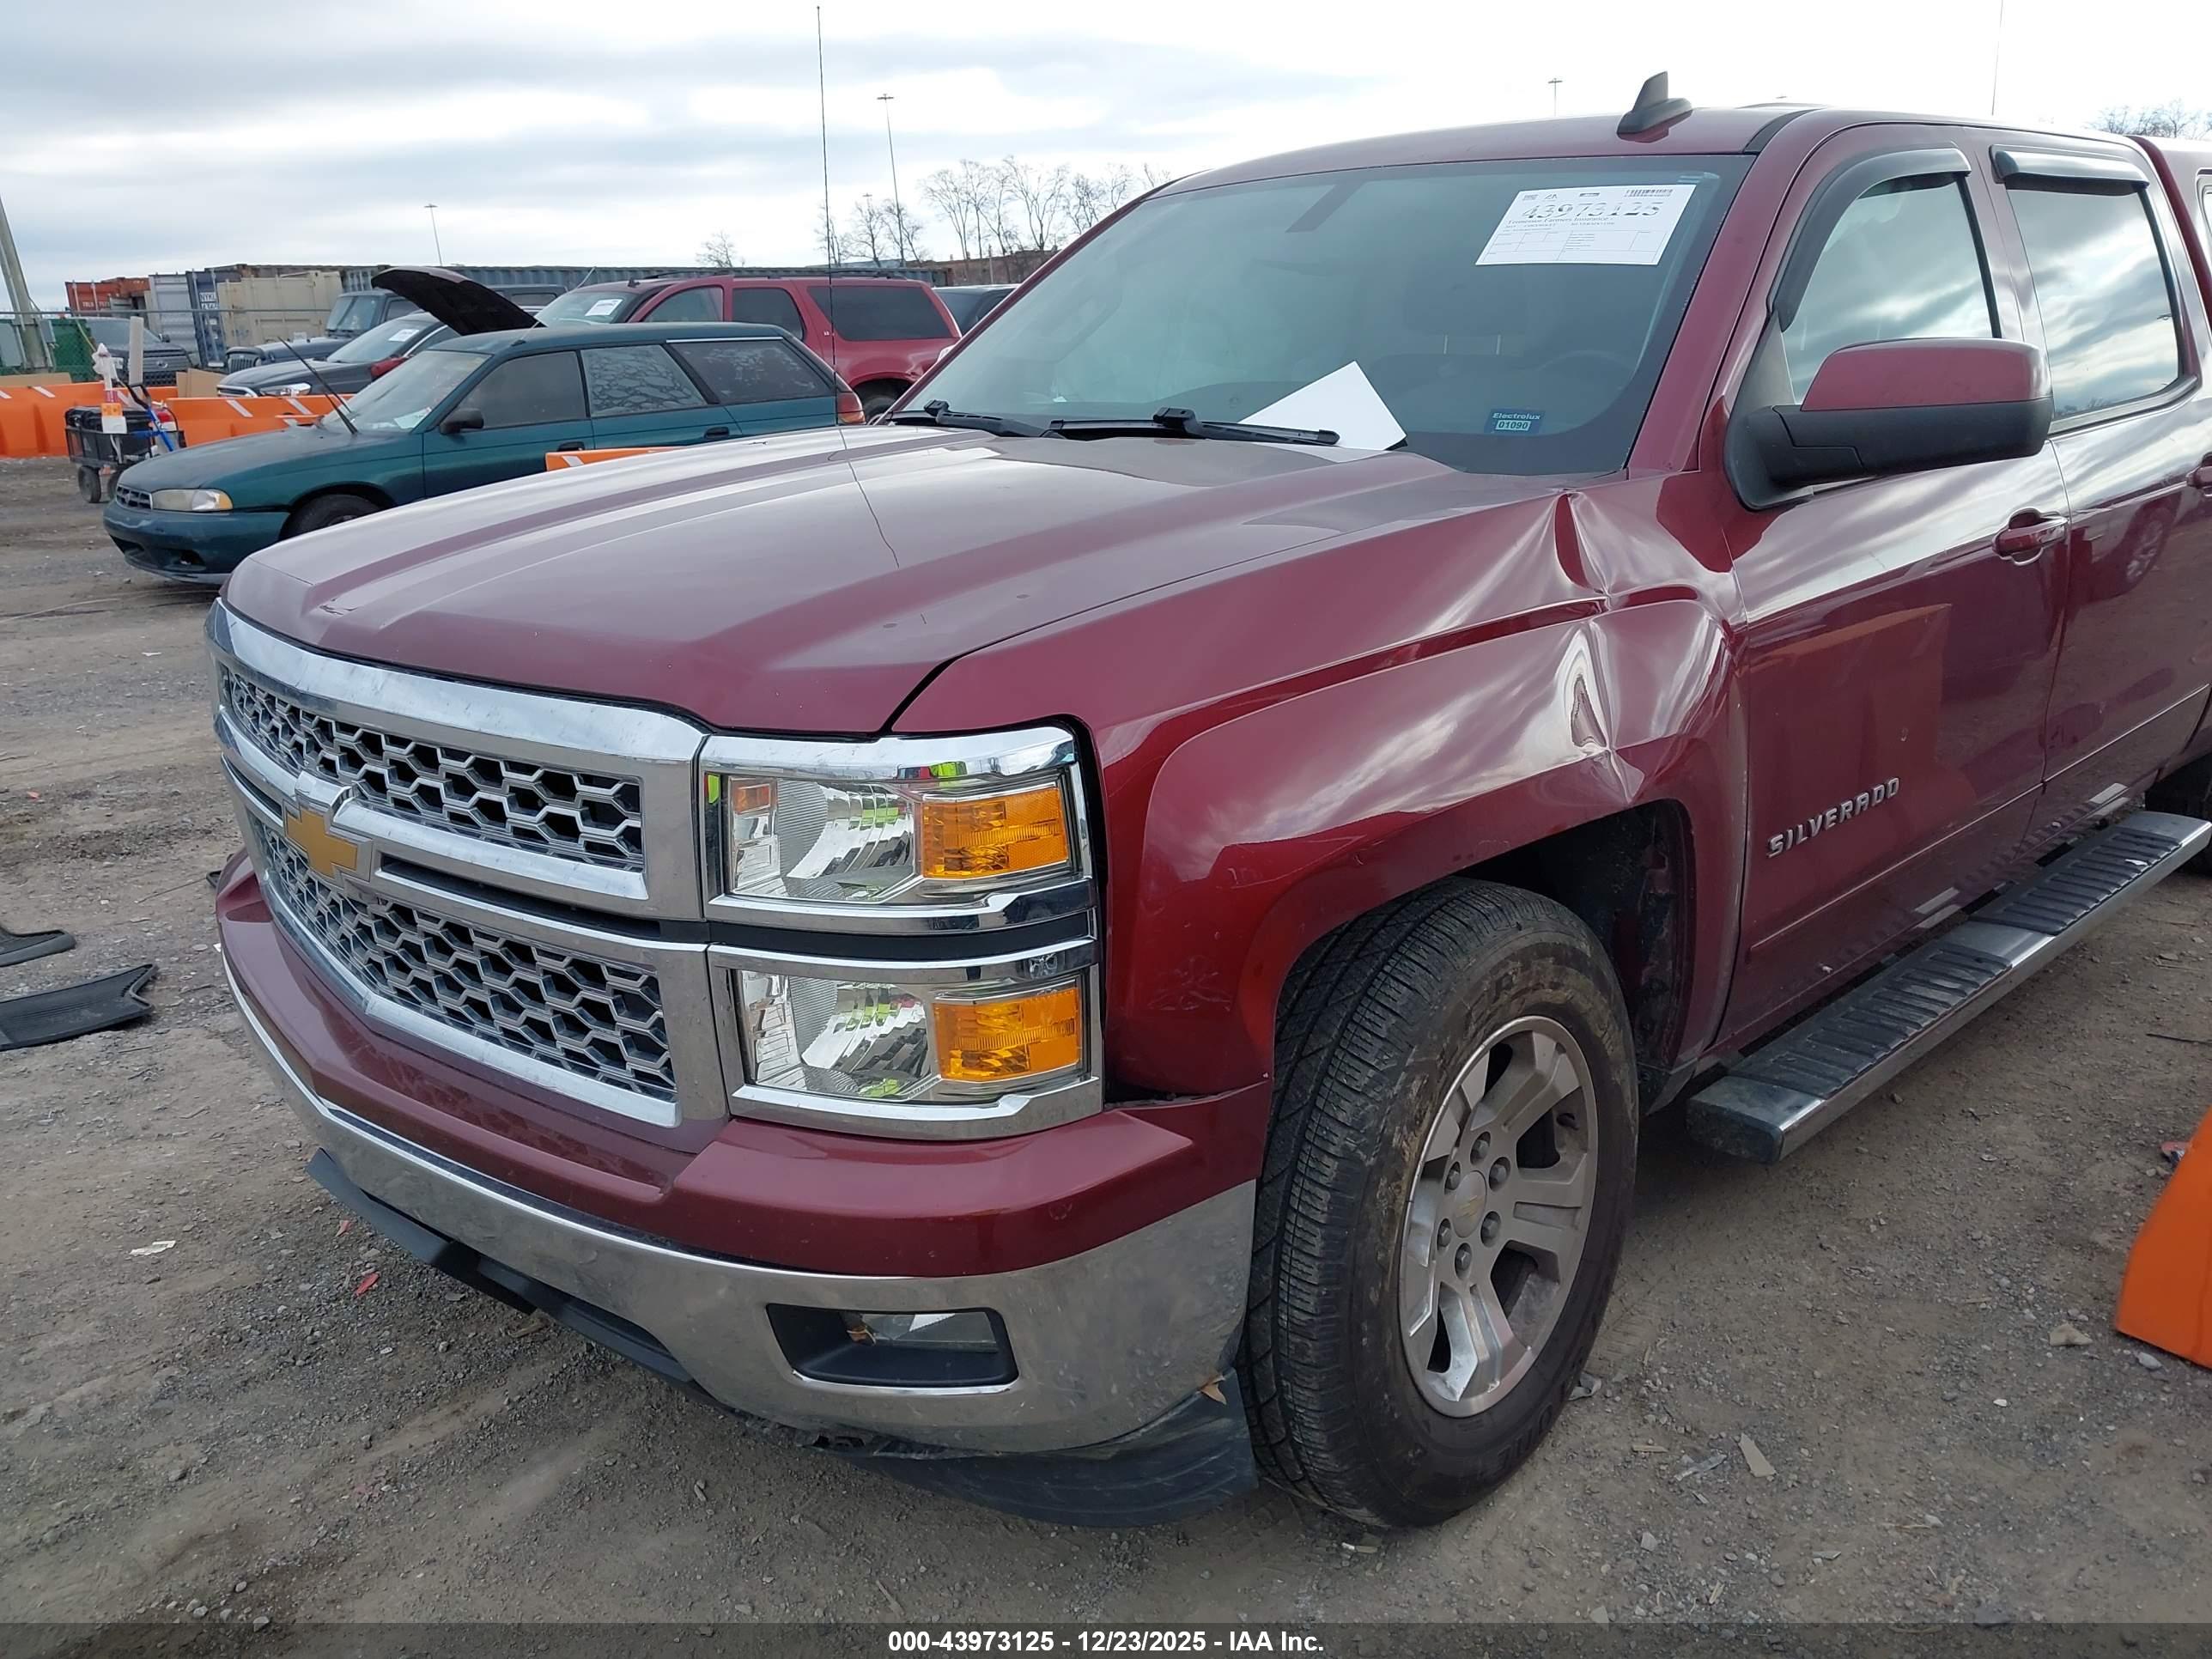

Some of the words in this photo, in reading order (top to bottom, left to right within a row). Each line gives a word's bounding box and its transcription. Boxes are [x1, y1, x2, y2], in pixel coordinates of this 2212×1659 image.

[1522, 202, 1663, 218] 43973125
[1498, 421, 1528, 429] 01090
[1766, 777, 1900, 859] SILVERADO
